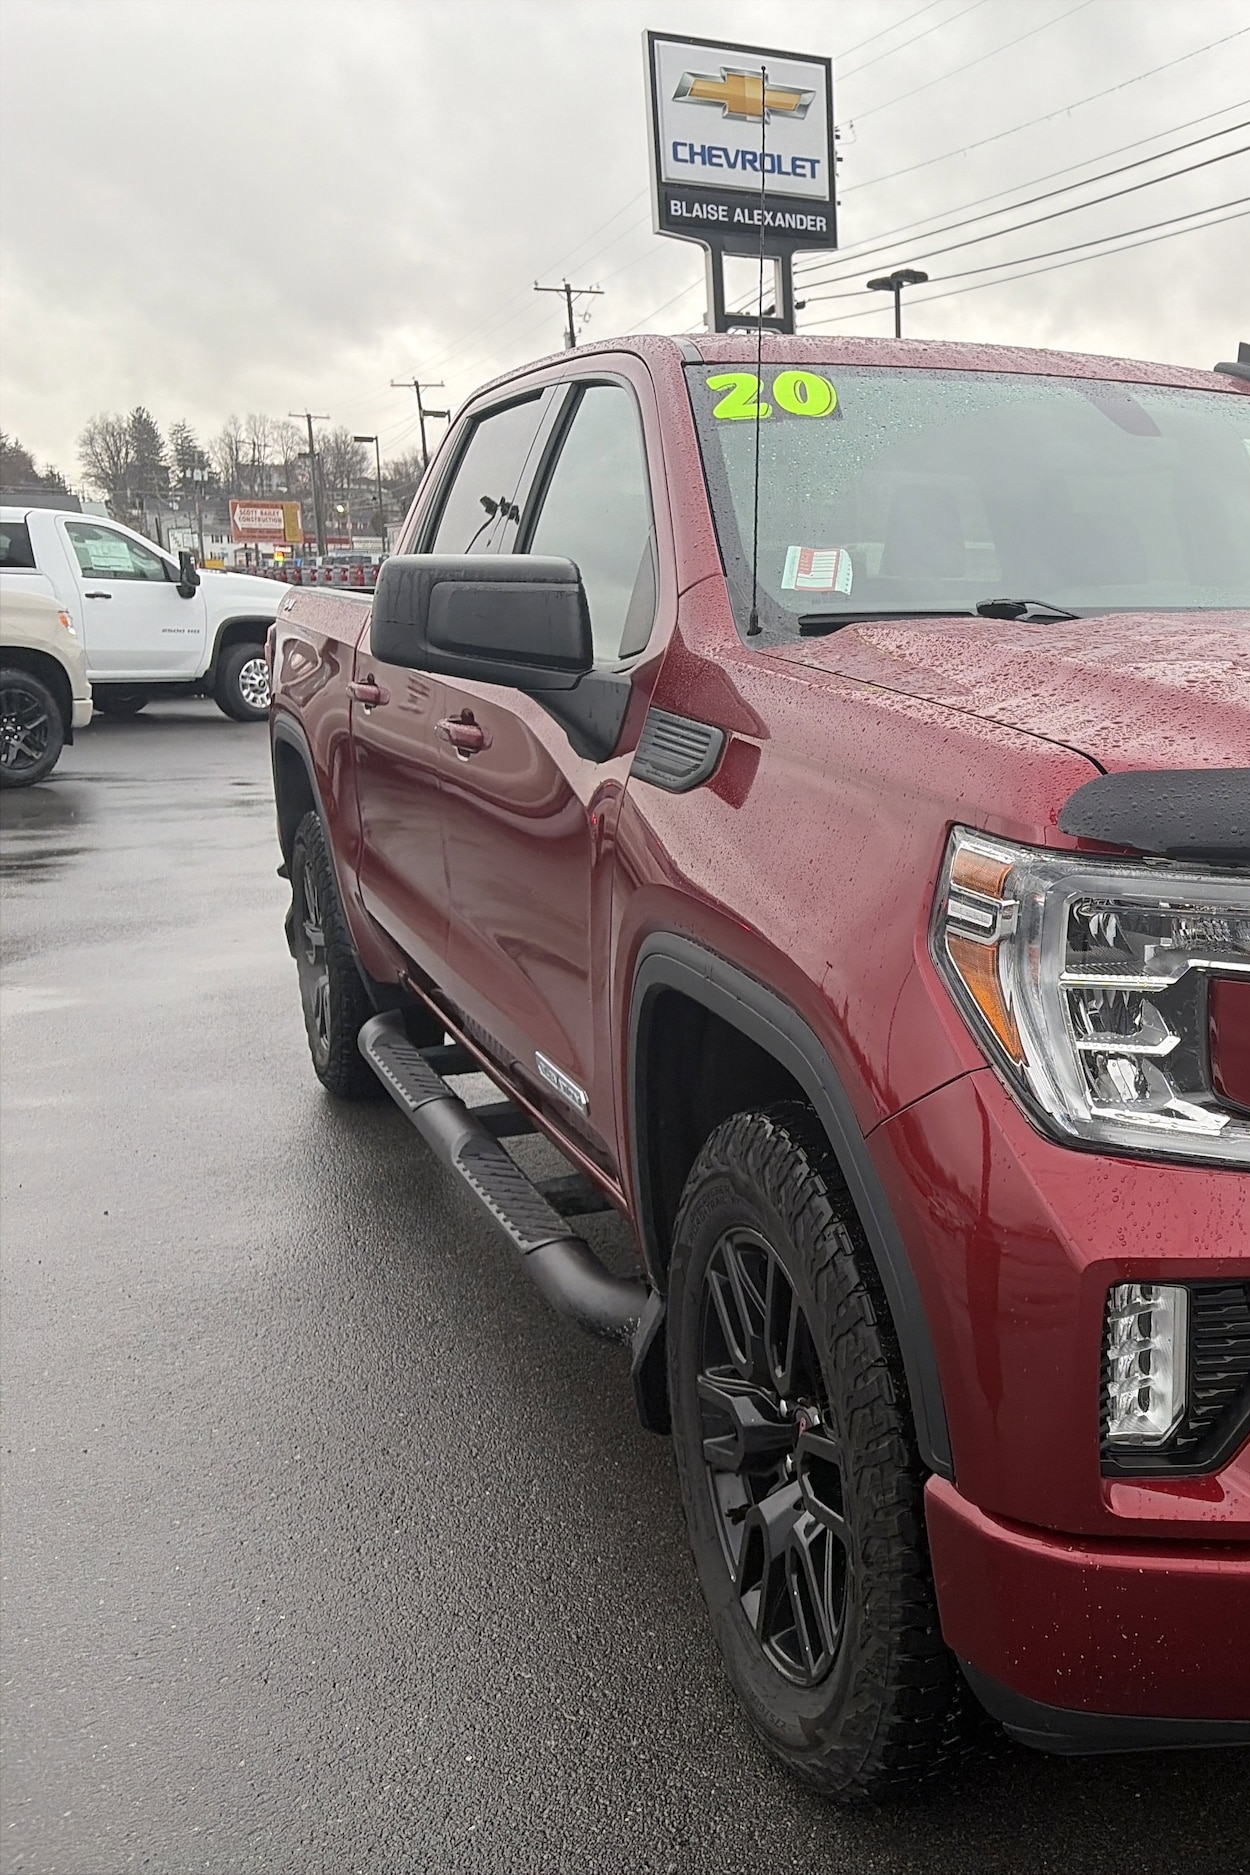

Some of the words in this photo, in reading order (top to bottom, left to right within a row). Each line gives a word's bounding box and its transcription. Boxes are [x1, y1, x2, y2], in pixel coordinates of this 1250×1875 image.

[672, 141, 821, 180] CHEVROLET
[670, 200, 729, 222] BLAISE
[733, 207, 827, 232] ALEXANDER
[706, 370, 838, 420] 20
